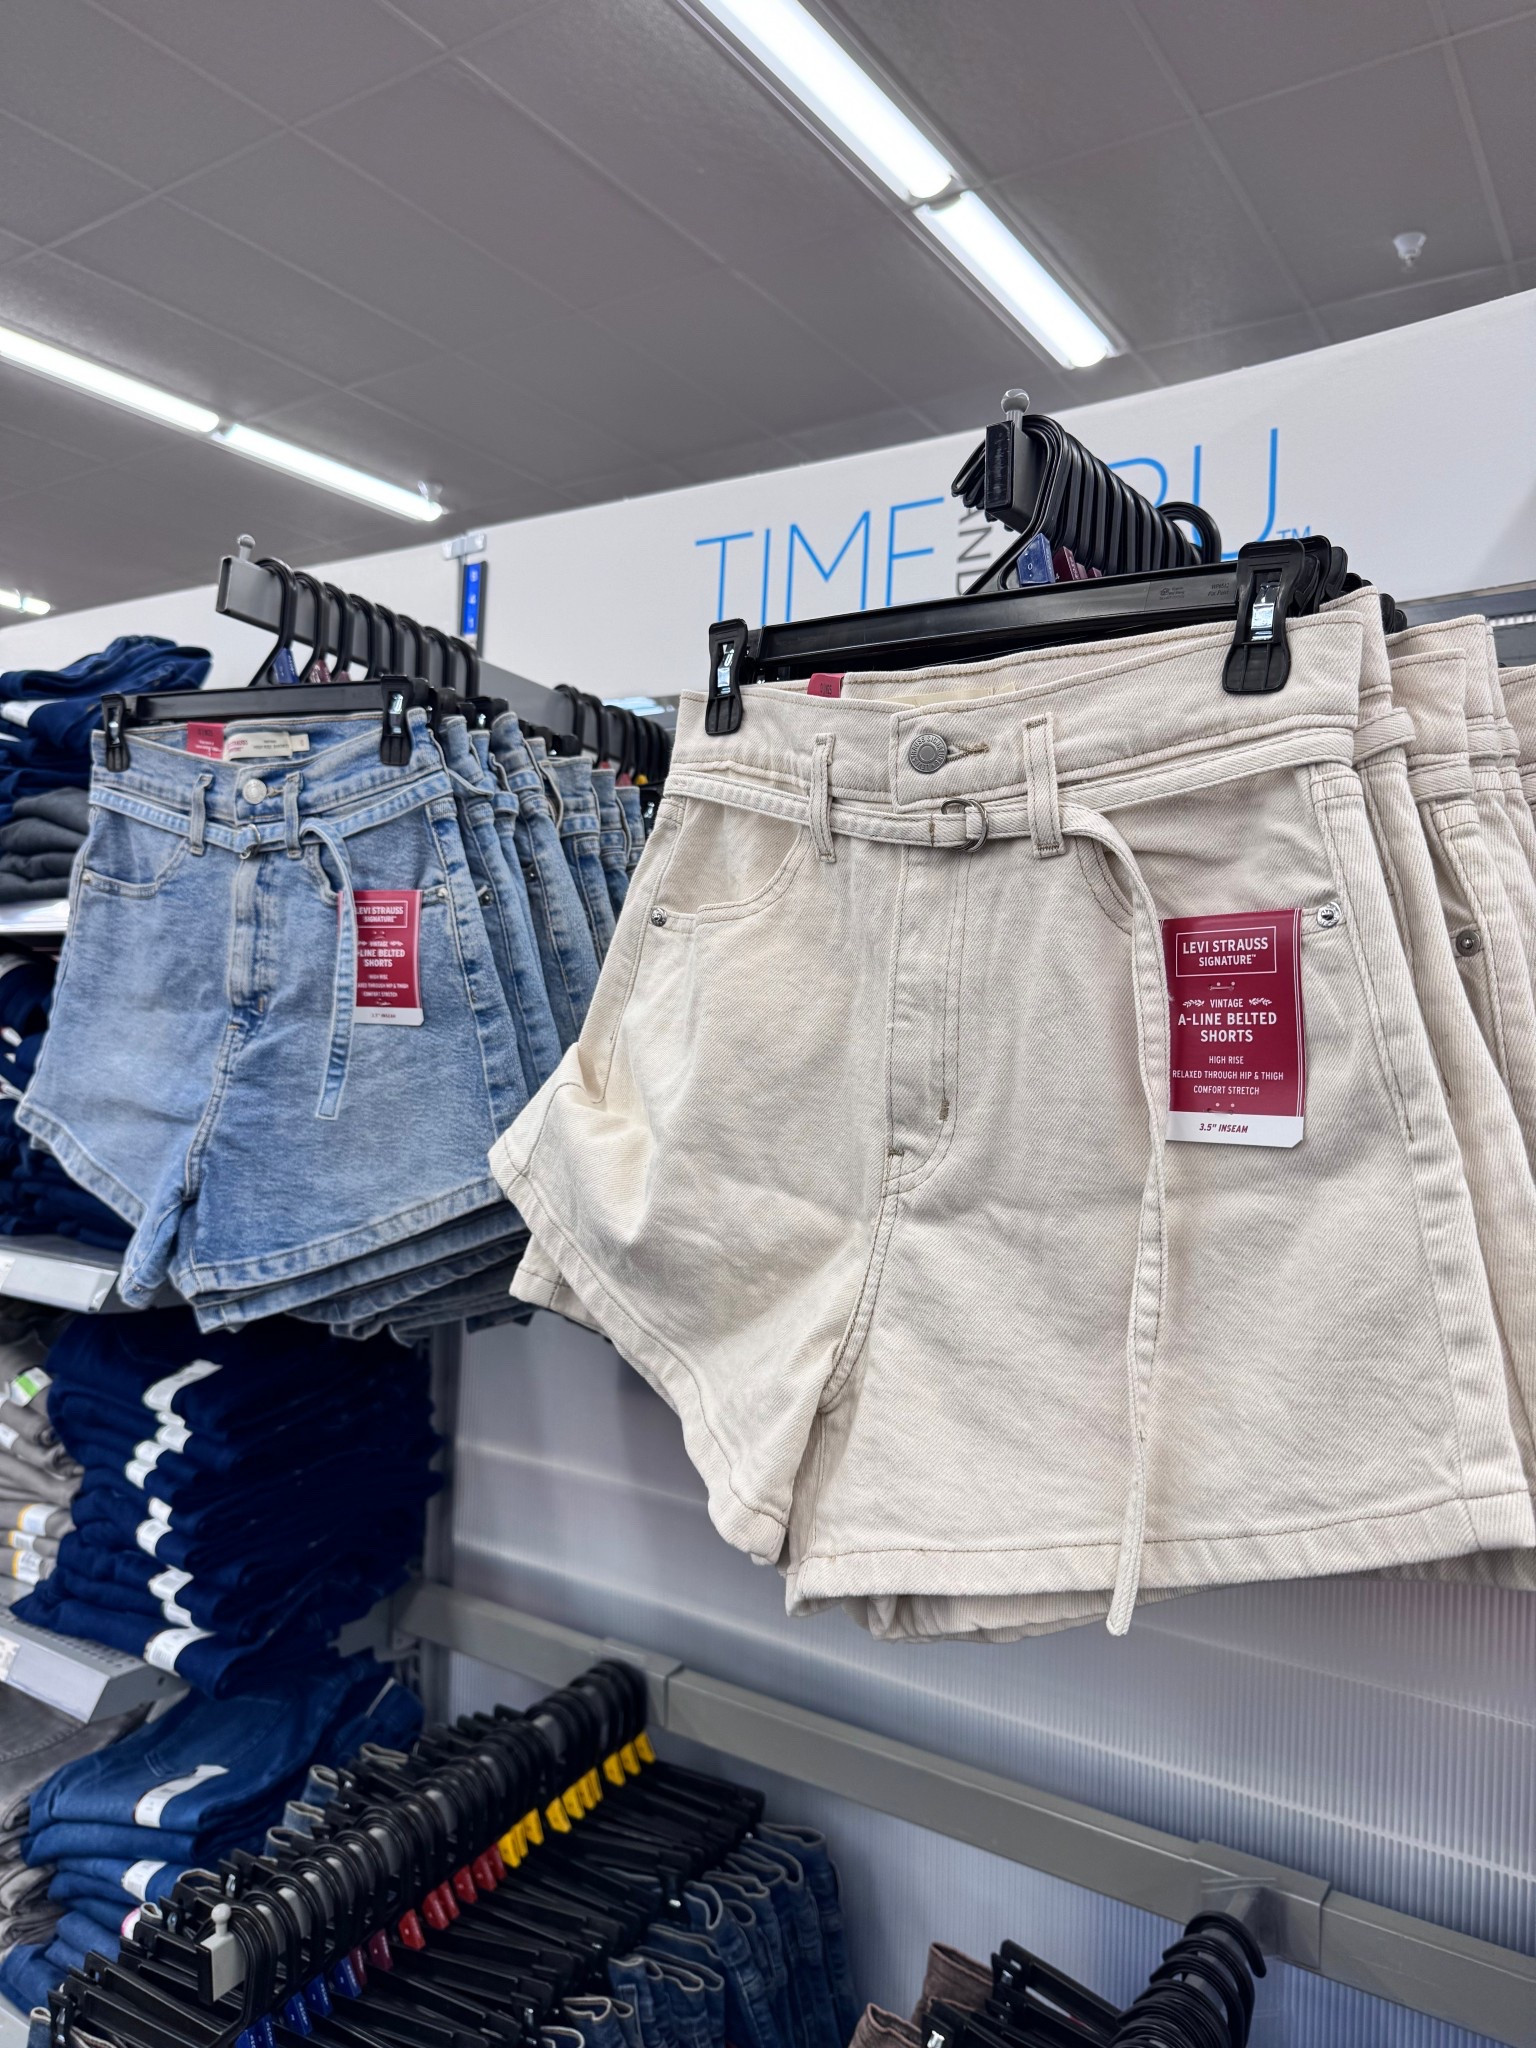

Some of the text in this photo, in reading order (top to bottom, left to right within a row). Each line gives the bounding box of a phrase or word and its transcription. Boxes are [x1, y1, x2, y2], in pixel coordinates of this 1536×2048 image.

[372, 906, 404, 915] STRAUSS
[1182, 937, 1269, 954] LEVI STRAUSS
[357, 948, 406, 957] -LINE BELTED
[364, 958, 393, 967] SHORTS
[1209, 998, 1244, 1009] VINTAGE
[1178, 1011, 1277, 1026] A-LINE BELTED
[1200, 1029, 1254, 1043] SHORTS
[1208, 1055, 1244, 1065] HIGH RISE
[1172, 1069, 1284, 1081] RELAXED THROUGH HIP & THIGH
[1193, 1085, 1260, 1096] COMFORT STRETCH
[1218, 1123, 1249, 1134] INSEAM
